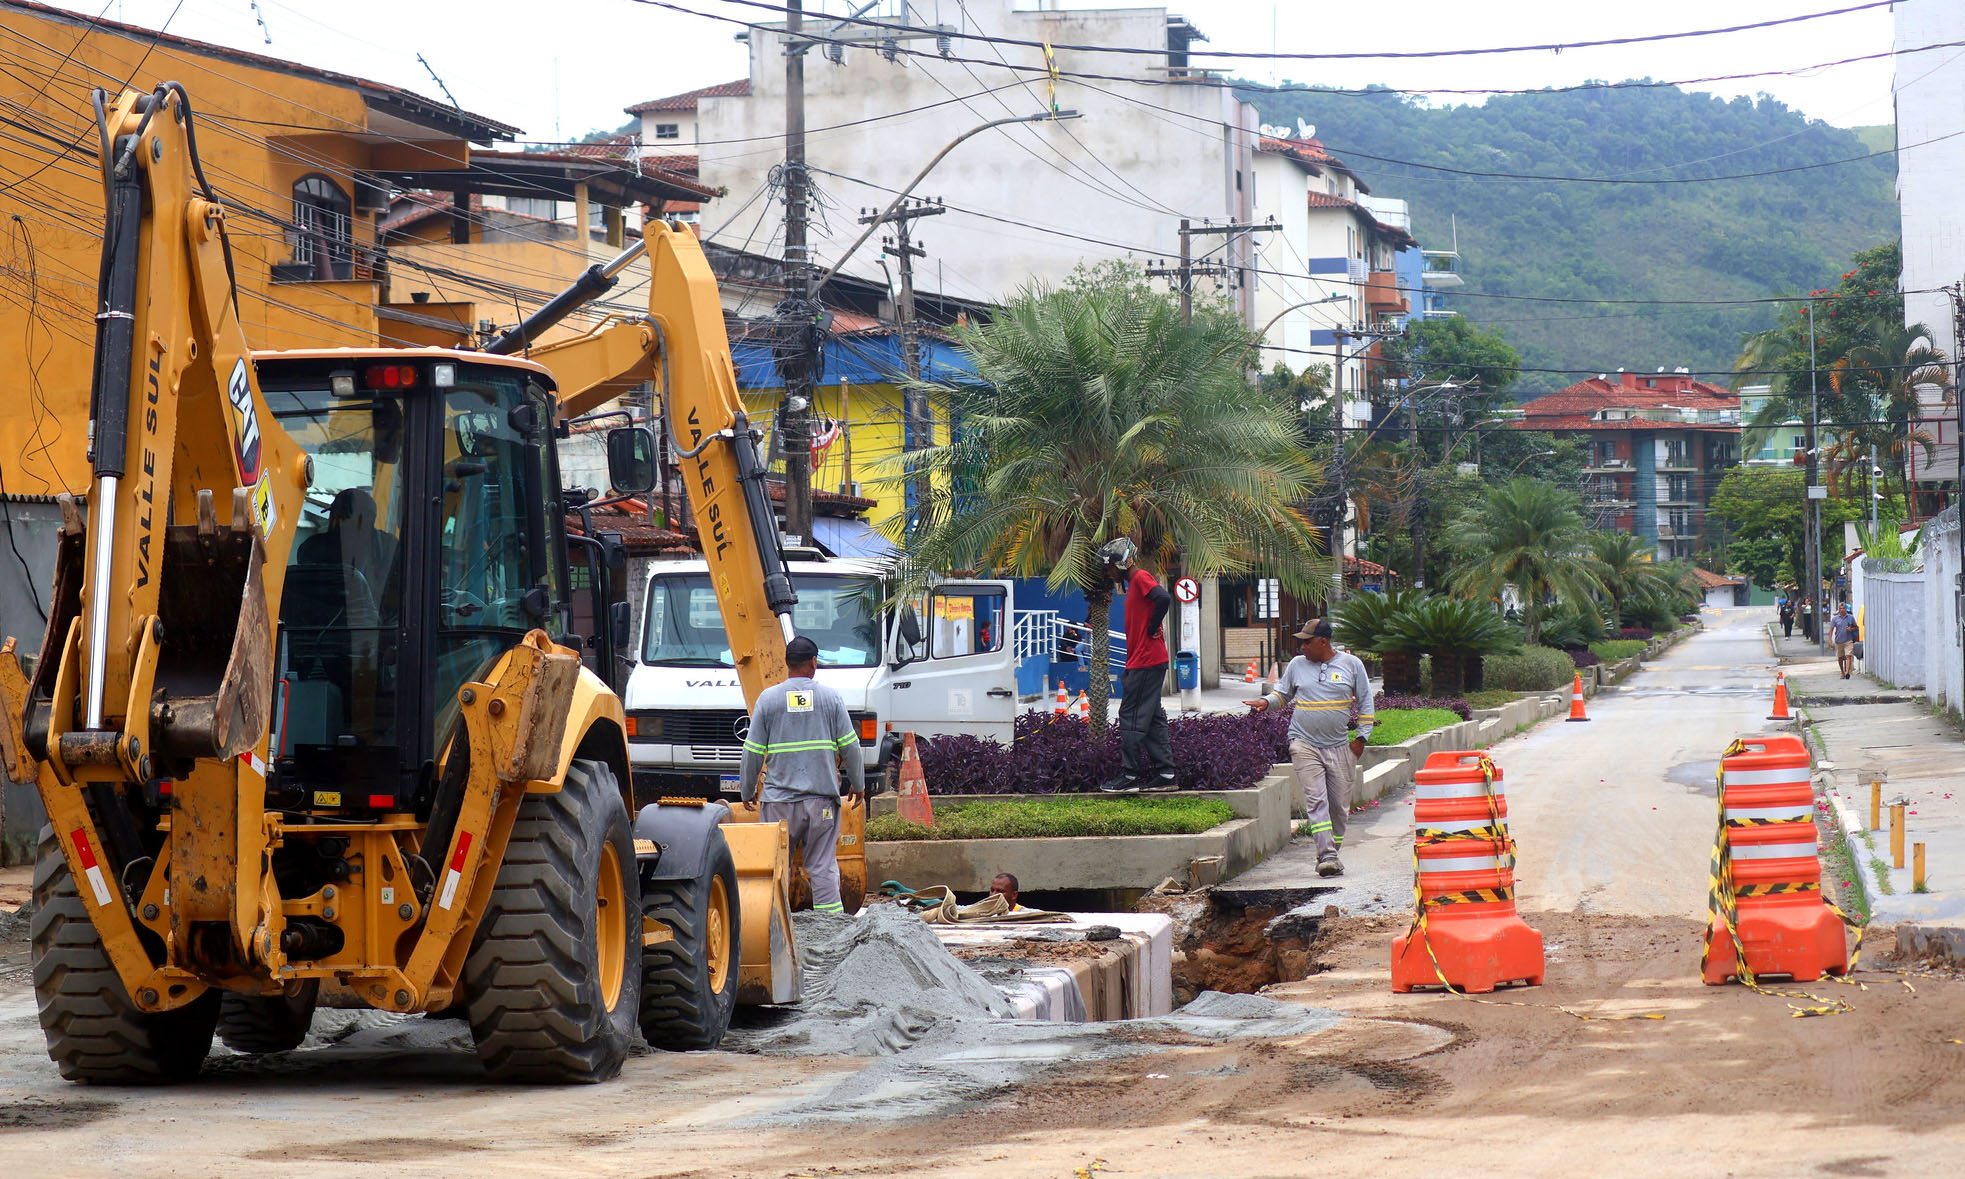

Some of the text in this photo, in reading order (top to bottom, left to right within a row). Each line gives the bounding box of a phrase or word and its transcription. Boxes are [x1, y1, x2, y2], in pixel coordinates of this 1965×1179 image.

[229, 357, 260, 458] CAT
[138, 351, 161, 588] VALLE SUL
[709, 503, 727, 561] SUL
[794, 695, 807, 706] Te
